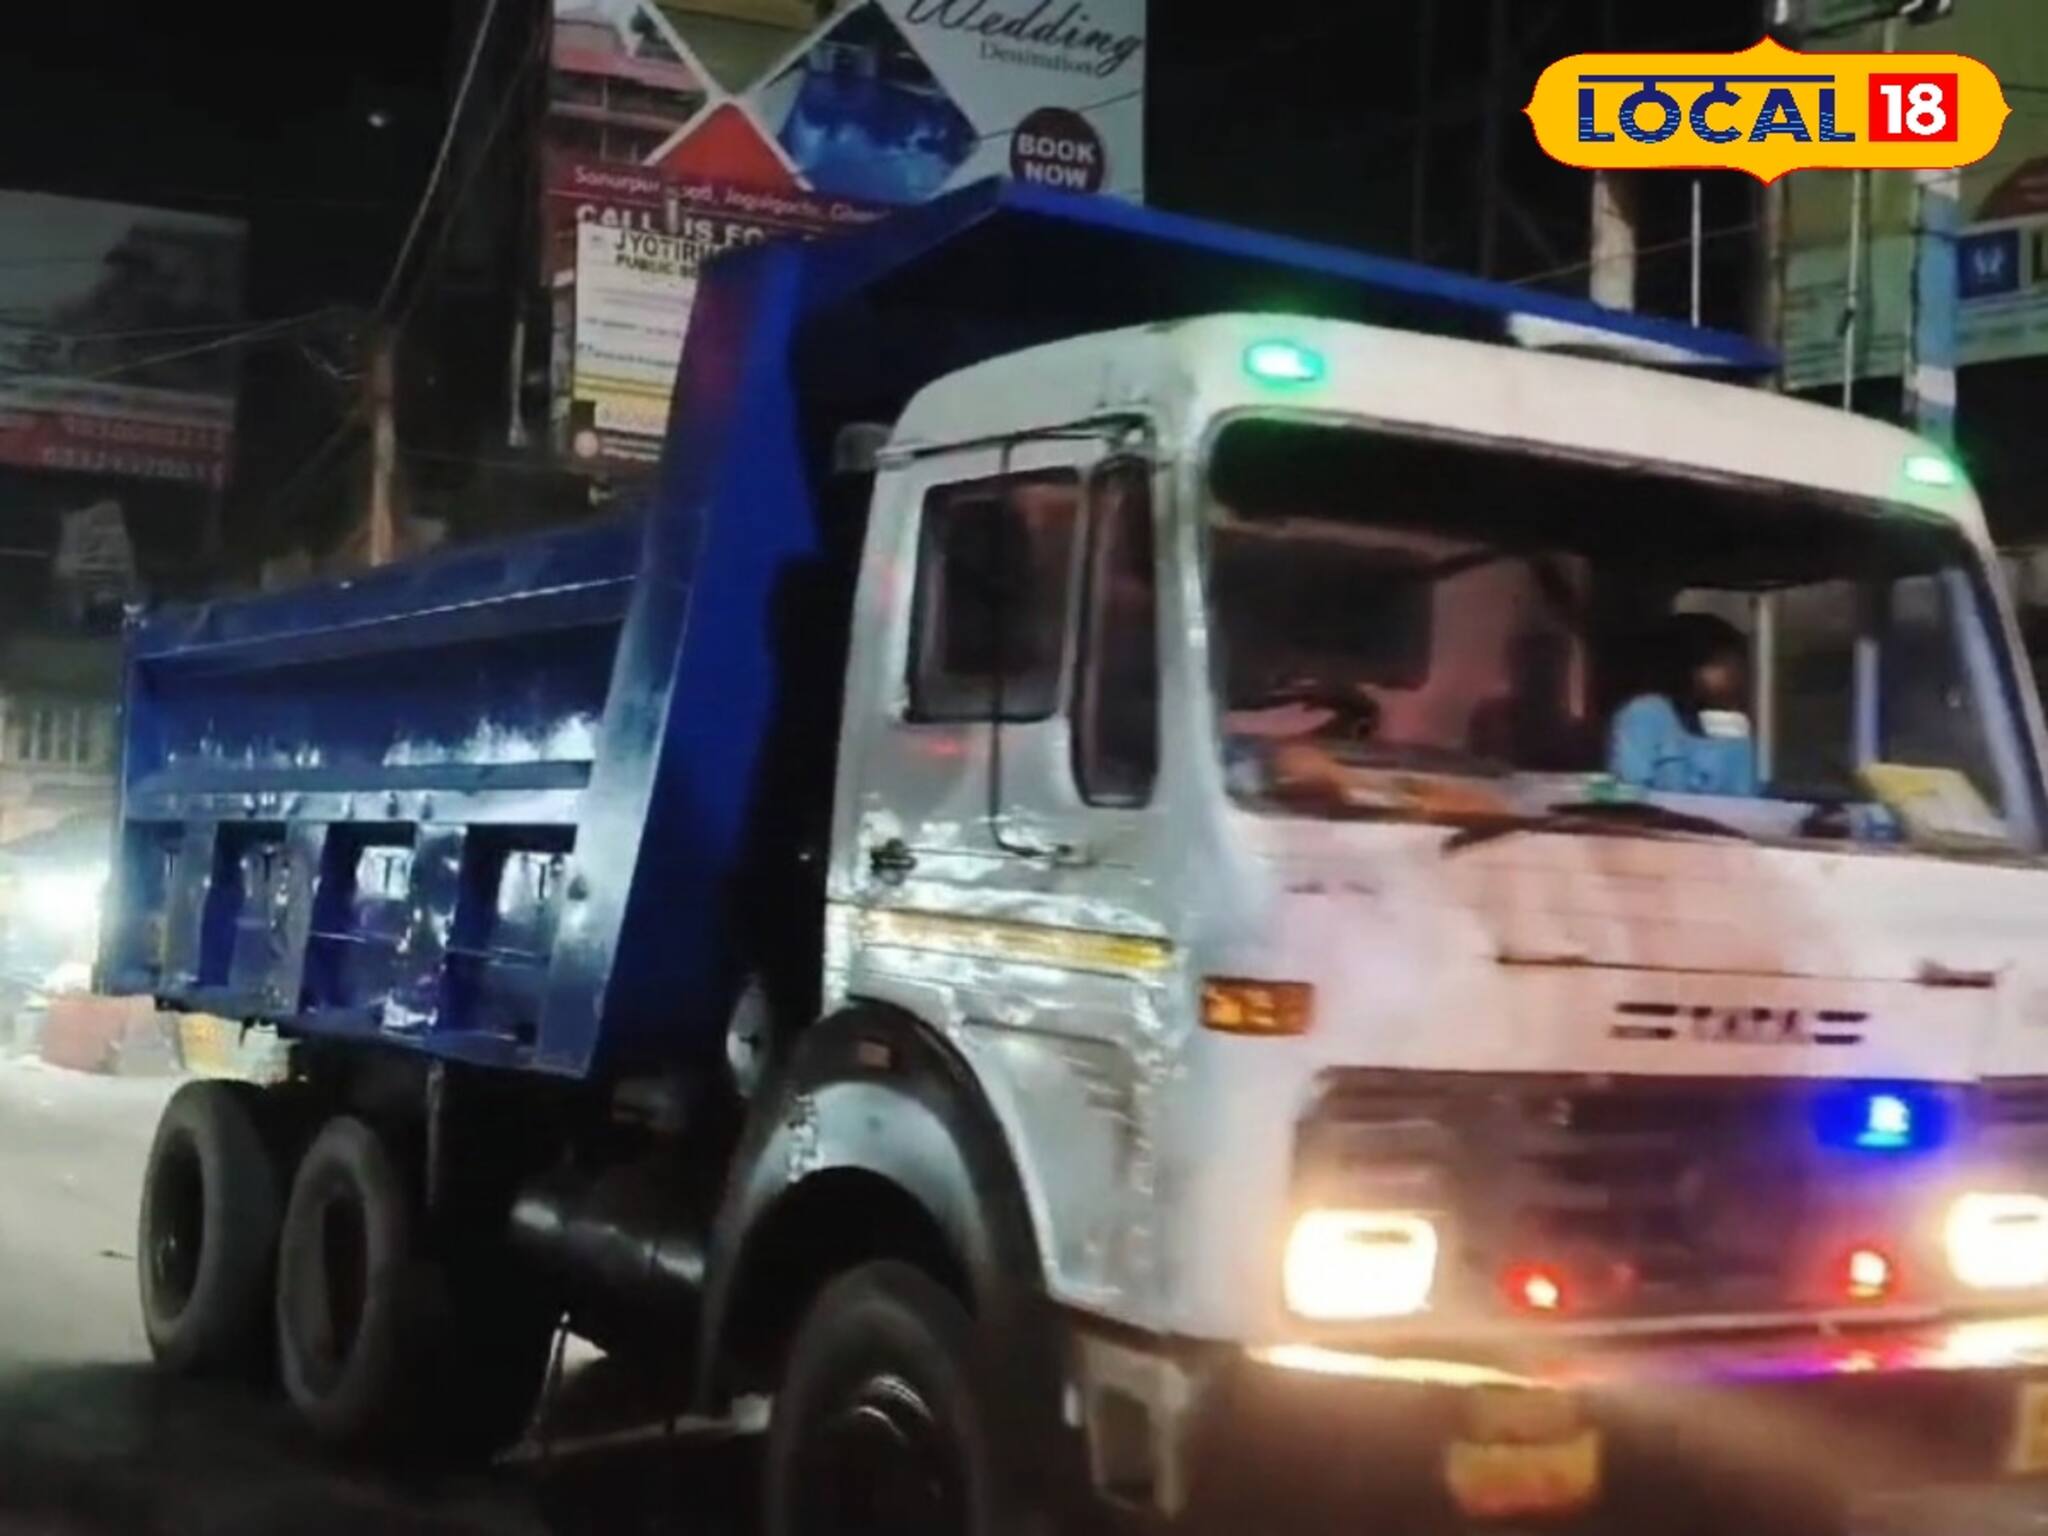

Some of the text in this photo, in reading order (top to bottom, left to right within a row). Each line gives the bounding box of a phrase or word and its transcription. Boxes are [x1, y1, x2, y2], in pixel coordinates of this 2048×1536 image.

[1017, 134, 1096, 163] BOOK
[1024, 160, 1088, 189] NOW
[614, 231, 706, 263] JYOTIR
[1692, 1005, 1808, 1044] TATA
